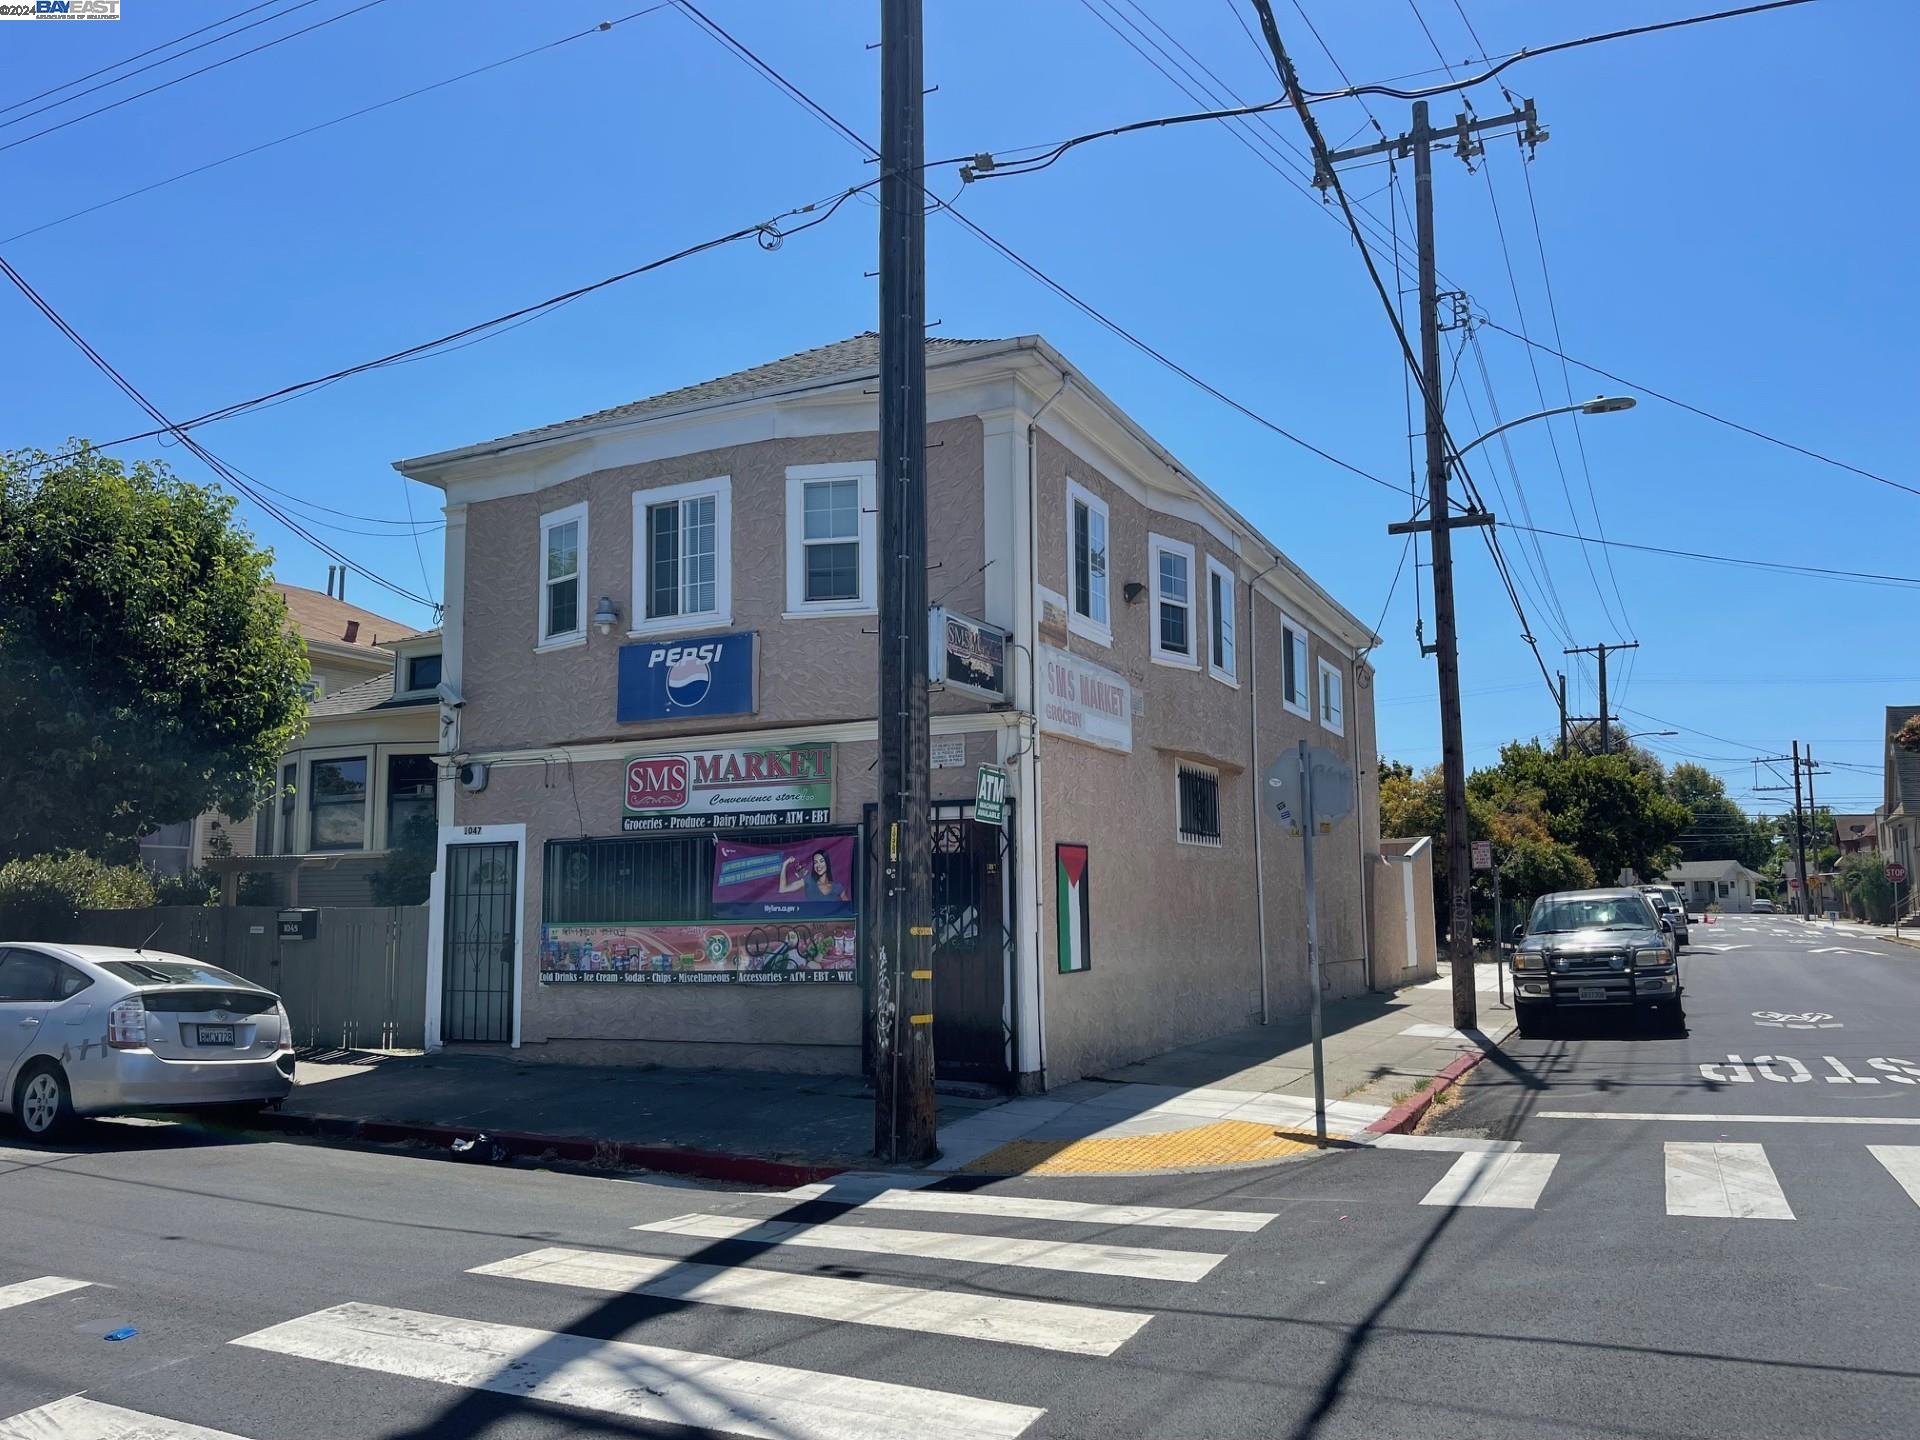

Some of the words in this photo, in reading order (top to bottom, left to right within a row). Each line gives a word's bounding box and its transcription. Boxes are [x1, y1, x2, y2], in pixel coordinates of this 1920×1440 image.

[648, 644, 723, 668] PEPSI
[1047, 662, 1075, 702] SMS
[1080, 676, 1125, 717] MARKET
[1046, 703, 1082, 728] GROCERY
[629, 766, 687, 793] SMS
[693, 750, 831, 784] MARKET
[709, 793, 772, 806] Convenience
[979, 773, 1004, 803] ATM
[464, 826, 482, 836] 1047
[624, 817, 663, 830] Groceries
[670, 815, 706, 829] Produce
[713, 813, 737, 829] Dairy
[739, 812, 777, 827] Products
[785, 811, 803, 825] ATM
[812, 810, 830, 823] EBT
[1885, 868, 1905, 877] STOP
[540, 972, 553, 982] Cold
[555, 972, 578, 982] Drinks
[584, 972, 592, 982] Ice
[596, 972, 618, 982] Cream
[624, 972, 645, 983] Sodas
[652, 973, 672, 984] Chips
[678, 973, 730, 983] Miscellaneous
[738, 971, 783, 983] Accessories
[813, 971, 829, 982] EBT
[837, 971, 854, 982] WIC
[1698, 1054, 1920, 1085] STOP
